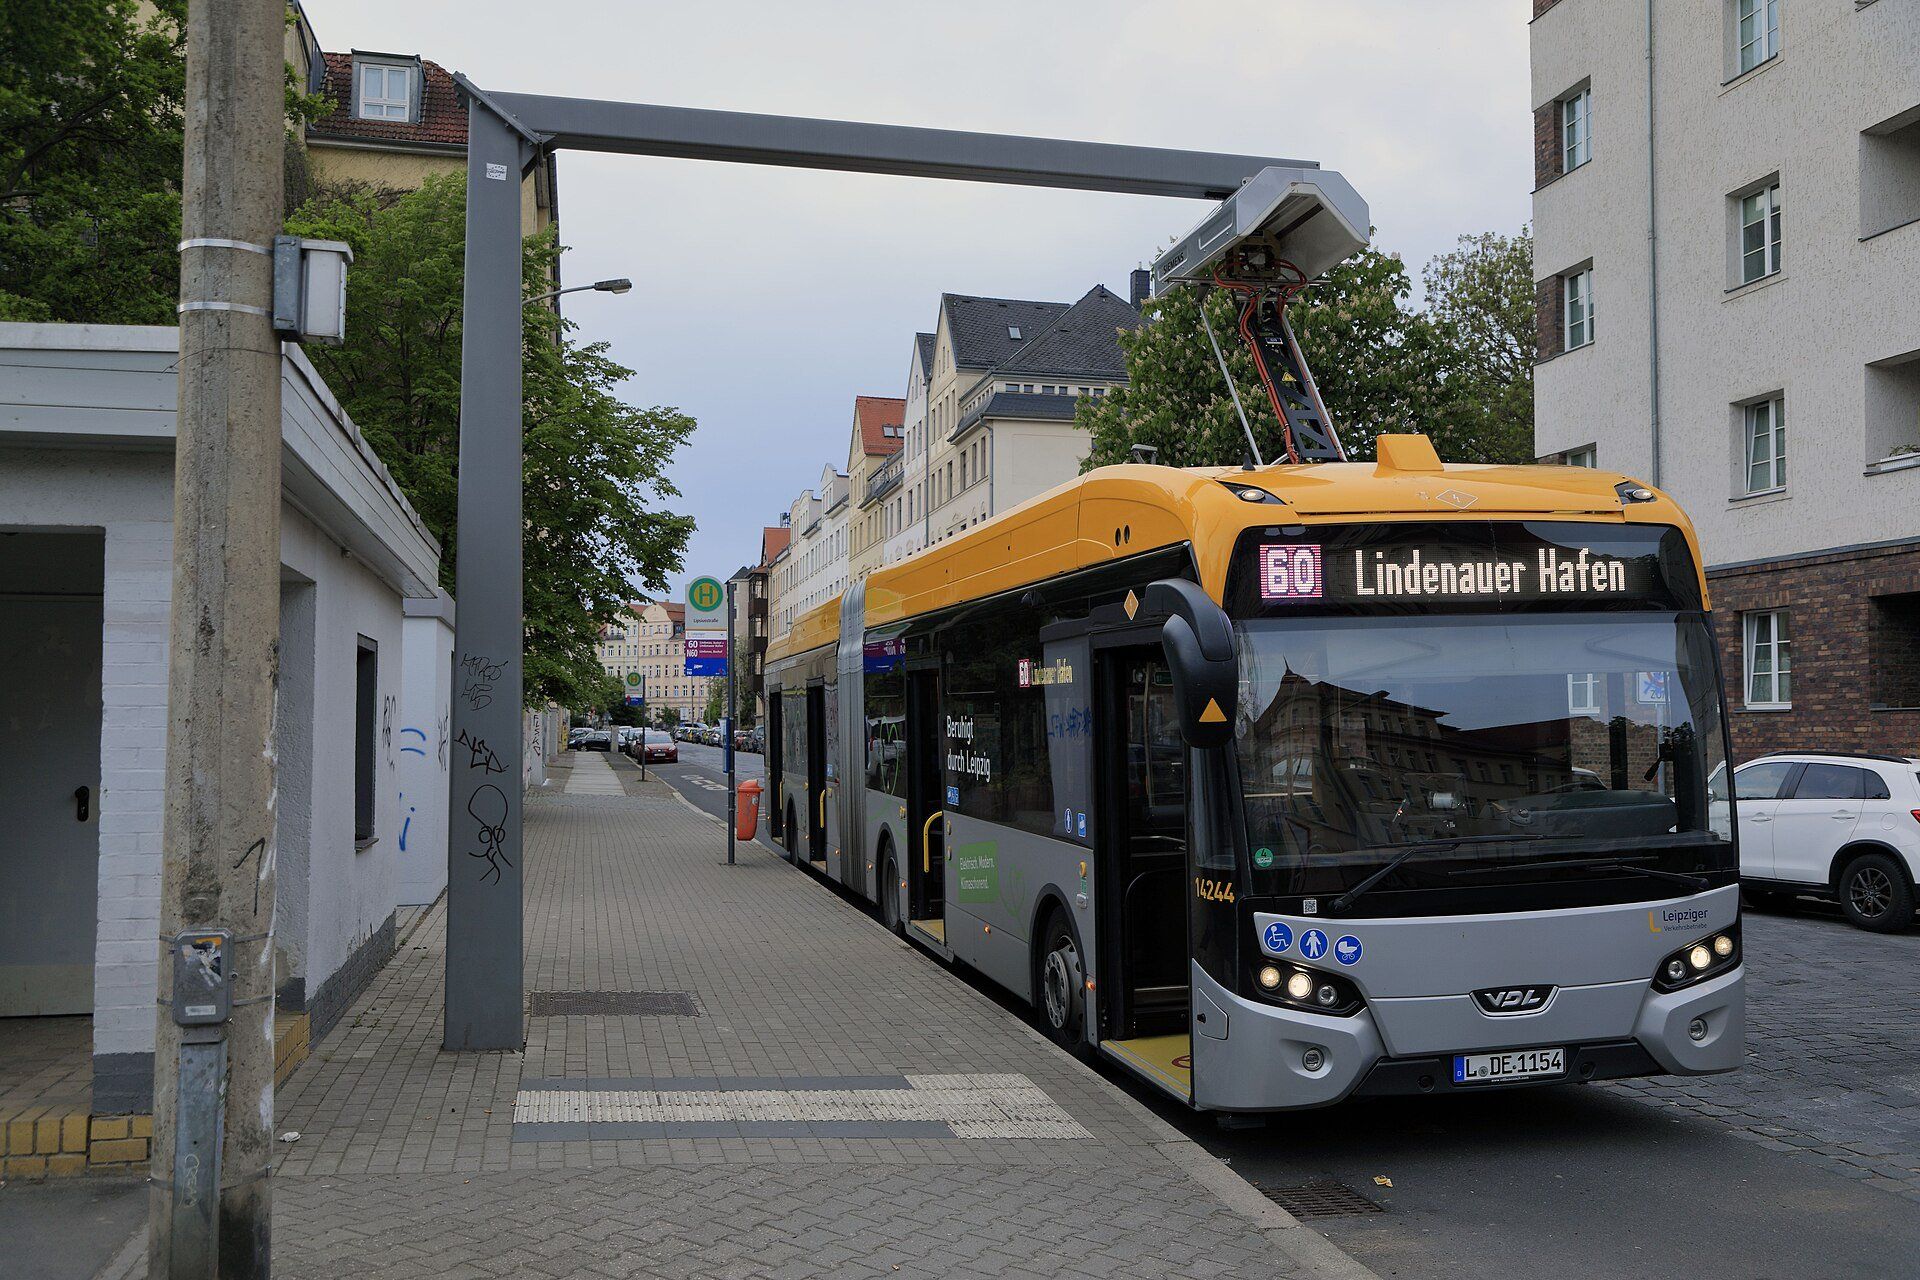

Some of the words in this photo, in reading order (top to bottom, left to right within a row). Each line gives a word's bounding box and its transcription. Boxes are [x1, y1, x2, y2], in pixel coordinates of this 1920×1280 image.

[1163, 252, 1184, 275] SIEMENS
[1267, 549, 1316, 594] 60
[1355, 549, 1526, 595] Lindenauer
[1538, 548, 1626, 593] Hafen
[686, 649, 698, 658] N60
[688, 640, 698, 649] 60
[946, 715, 973, 745] Beruhigt
[947, 748, 965, 772] durch
[966, 750, 990, 783] Leipzig
[1195, 877, 1235, 903] 14244
[1662, 909, 1709, 923] Leipziger
[1663, 923, 1707, 932] Verkehrsbetriebe
[1484, 990, 1540, 1007] VDL
[1466, 1059, 1477, 1077] L
